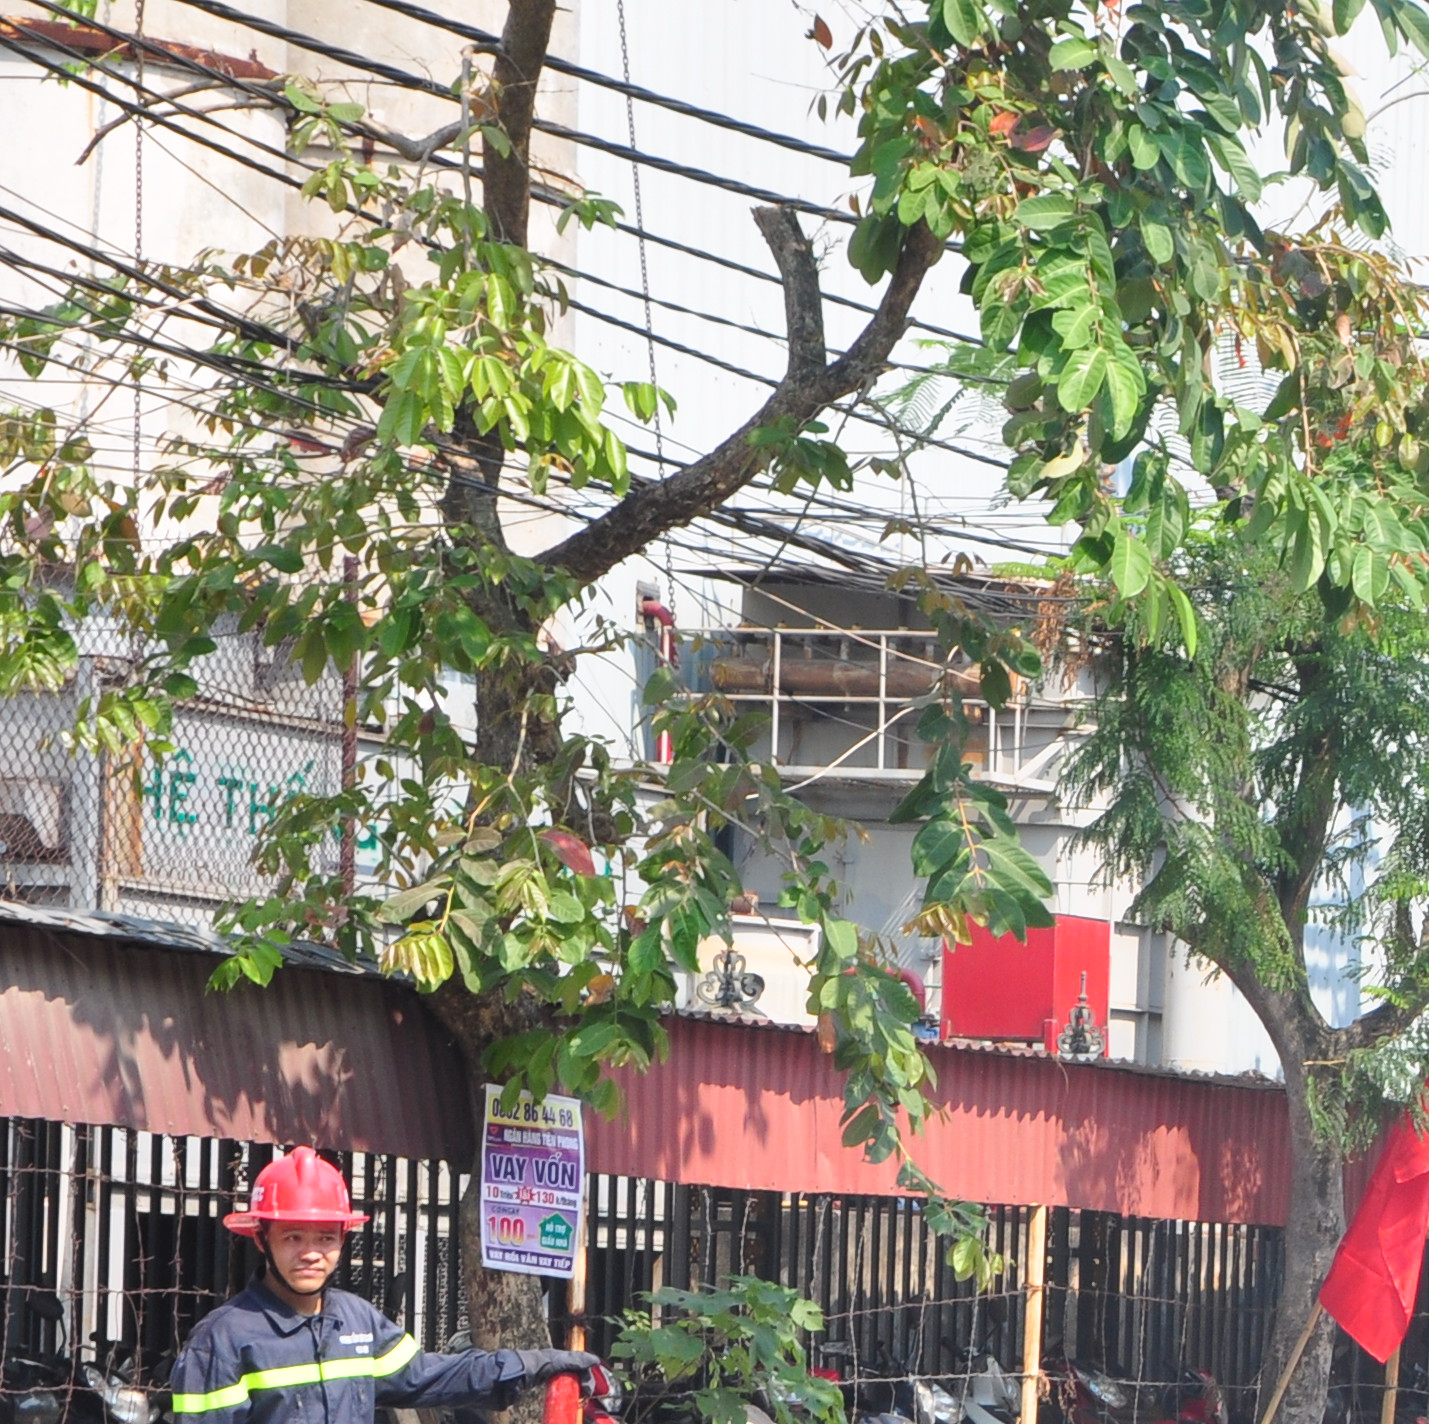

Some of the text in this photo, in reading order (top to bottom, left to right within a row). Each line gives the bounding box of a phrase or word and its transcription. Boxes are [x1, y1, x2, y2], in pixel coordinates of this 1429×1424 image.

[524, 1102, 539, 1122] 86
[542, 1106, 556, 1125] 44
[558, 1108, 574, 1128] 68
[491, 1152, 576, 1189] VAY VỐN
[487, 1186, 499, 1198] 10
[536, 1191, 555, 1204] 130
[487, 1215, 525, 1245] 100
